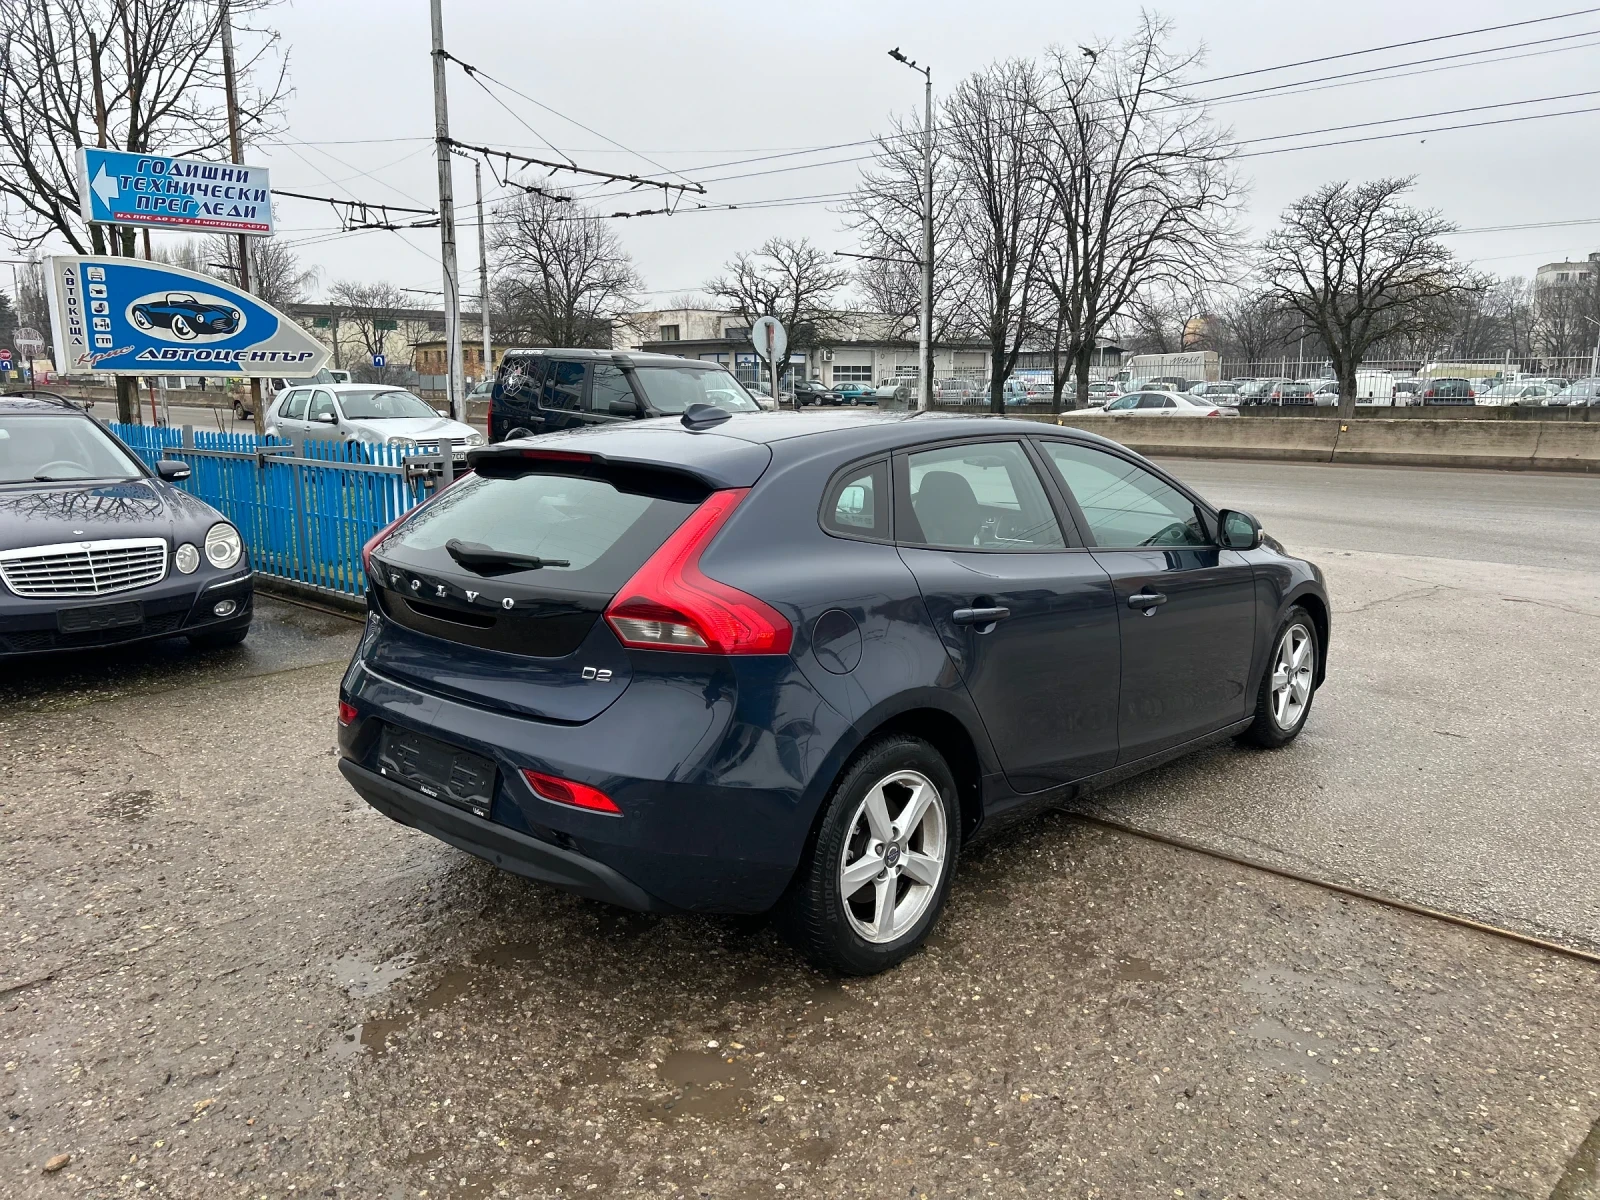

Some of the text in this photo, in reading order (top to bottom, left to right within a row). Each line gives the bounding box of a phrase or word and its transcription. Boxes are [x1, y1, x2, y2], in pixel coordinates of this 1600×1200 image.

[136, 159, 250, 184] ГОДИШНИ
[120, 175, 267, 203] ТЕХНИЧЕСКИ
[136, 195, 257, 219] ПРЕГЛЕДИ
[202, 219, 267, 230] МОТОЦИКЛЕТИ
[63, 267, 83, 346] АВТОКЪЩА
[96, 337, 112, 345] ГТП
[76, 346, 134, 366] Крис
[136, 348, 314, 363] АВТОЦЕНТЪР
[391, 574, 515, 610] VOLVO
[581, 666, 613, 682] D2
